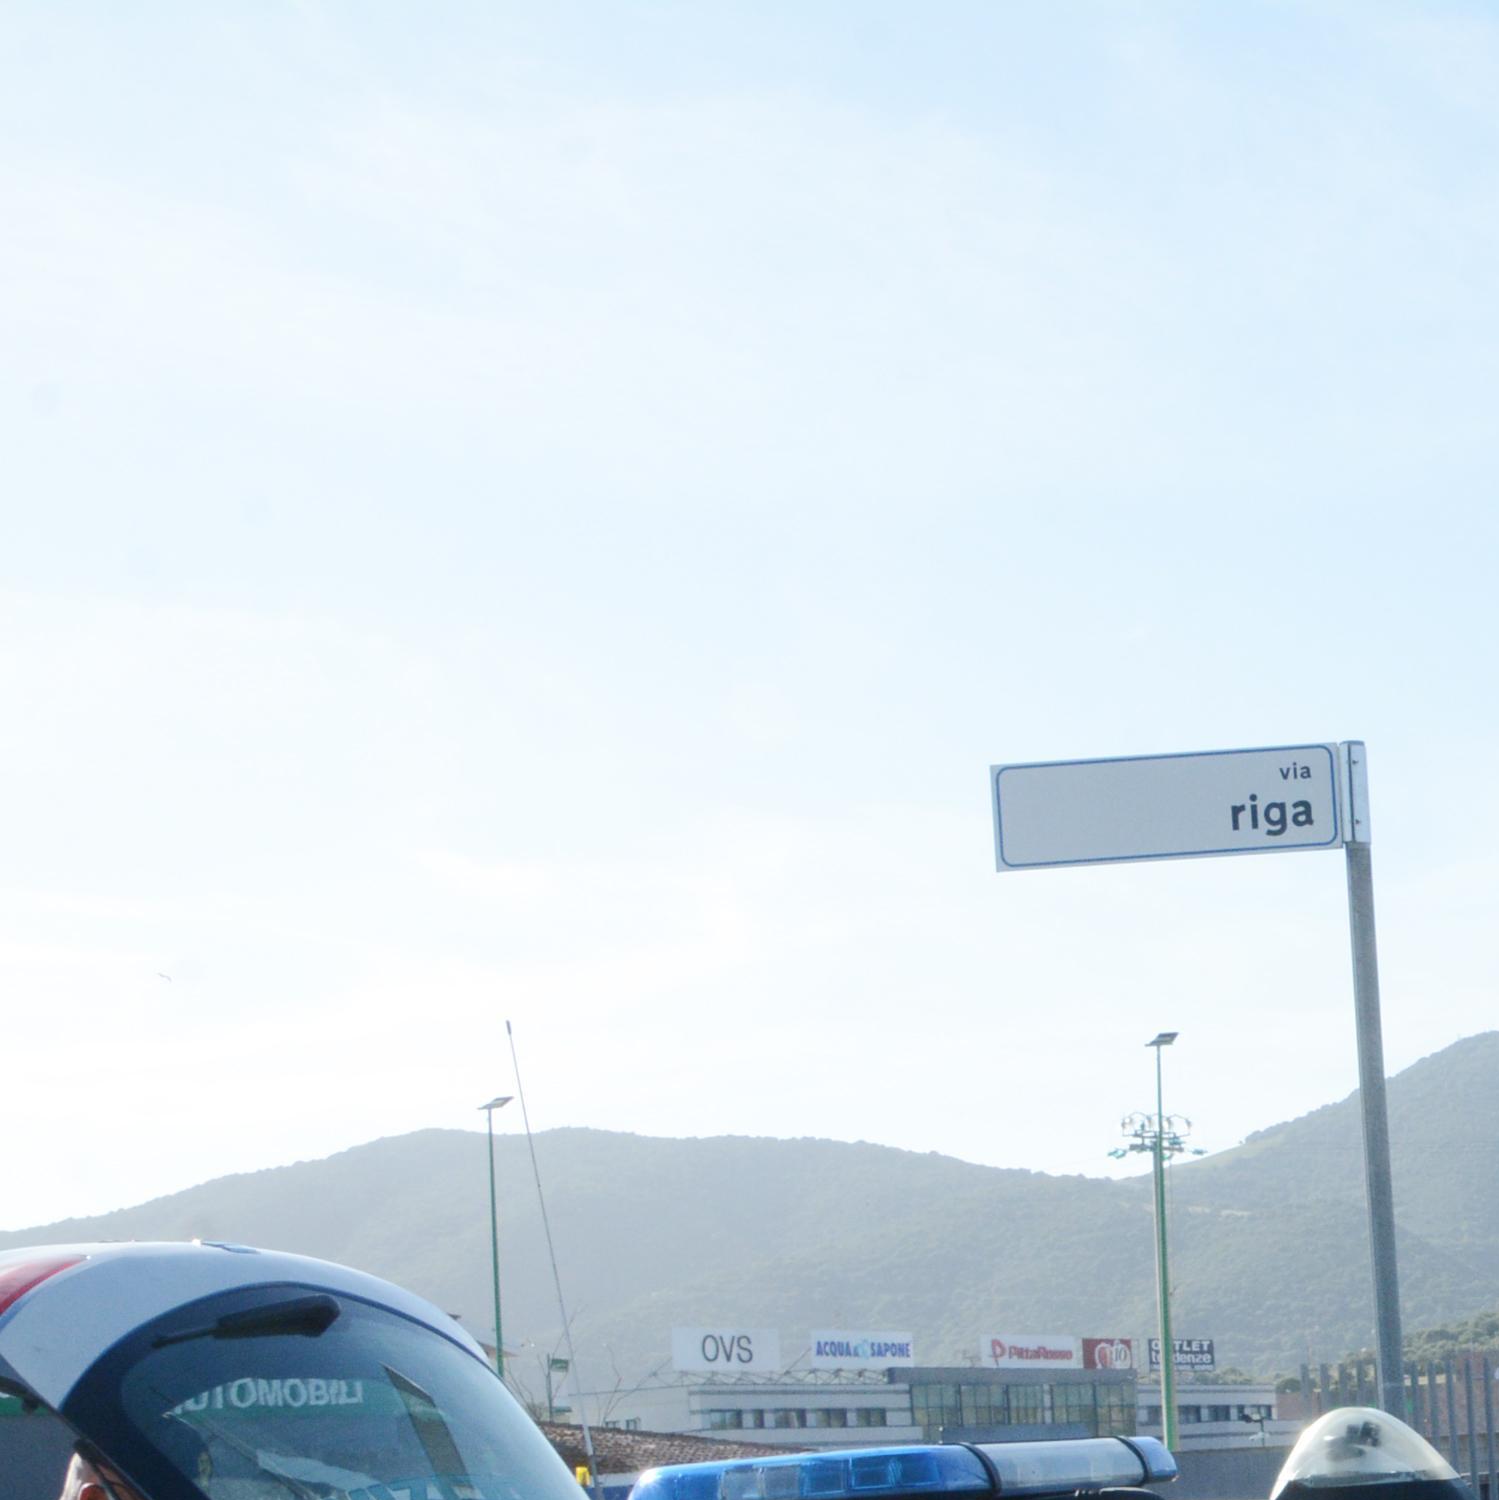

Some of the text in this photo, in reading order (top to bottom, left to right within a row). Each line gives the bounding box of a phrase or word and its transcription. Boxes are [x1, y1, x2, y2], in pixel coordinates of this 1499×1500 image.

[1279, 761, 1312, 781] via
[1230, 793, 1315, 837] riga
[701, 1333, 755, 1364] OVS
[815, 1340, 851, 1358] ACQUA
[869, 1341, 911, 1358] SAPONE
[1151, 1339, 1211, 1351] OTLET
